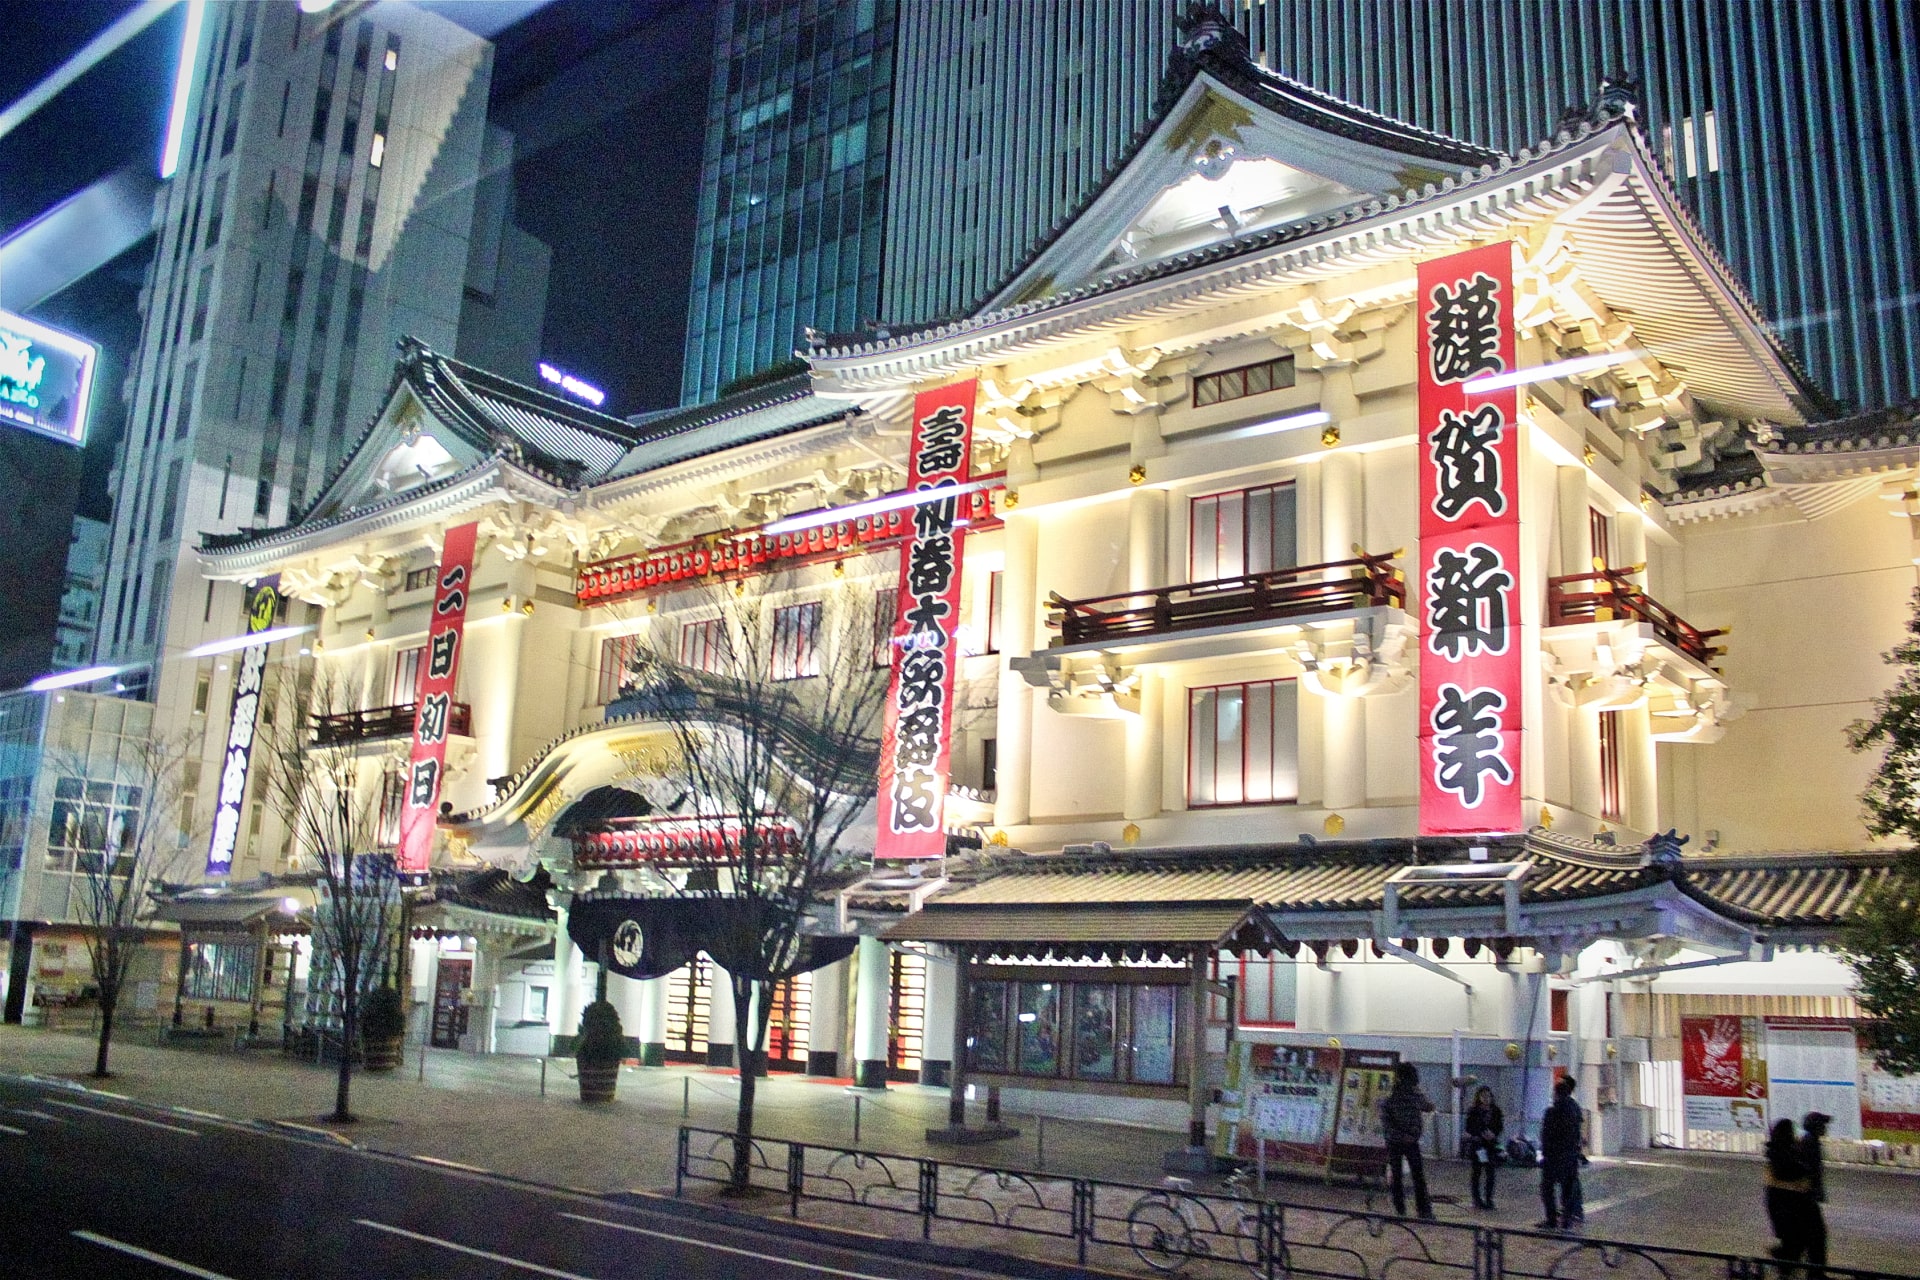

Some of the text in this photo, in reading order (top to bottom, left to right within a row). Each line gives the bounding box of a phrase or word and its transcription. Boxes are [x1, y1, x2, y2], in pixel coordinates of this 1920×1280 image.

[410, 565, 465, 808] 二日初日
[1426, 272, 1514, 808] 謹賀新年
